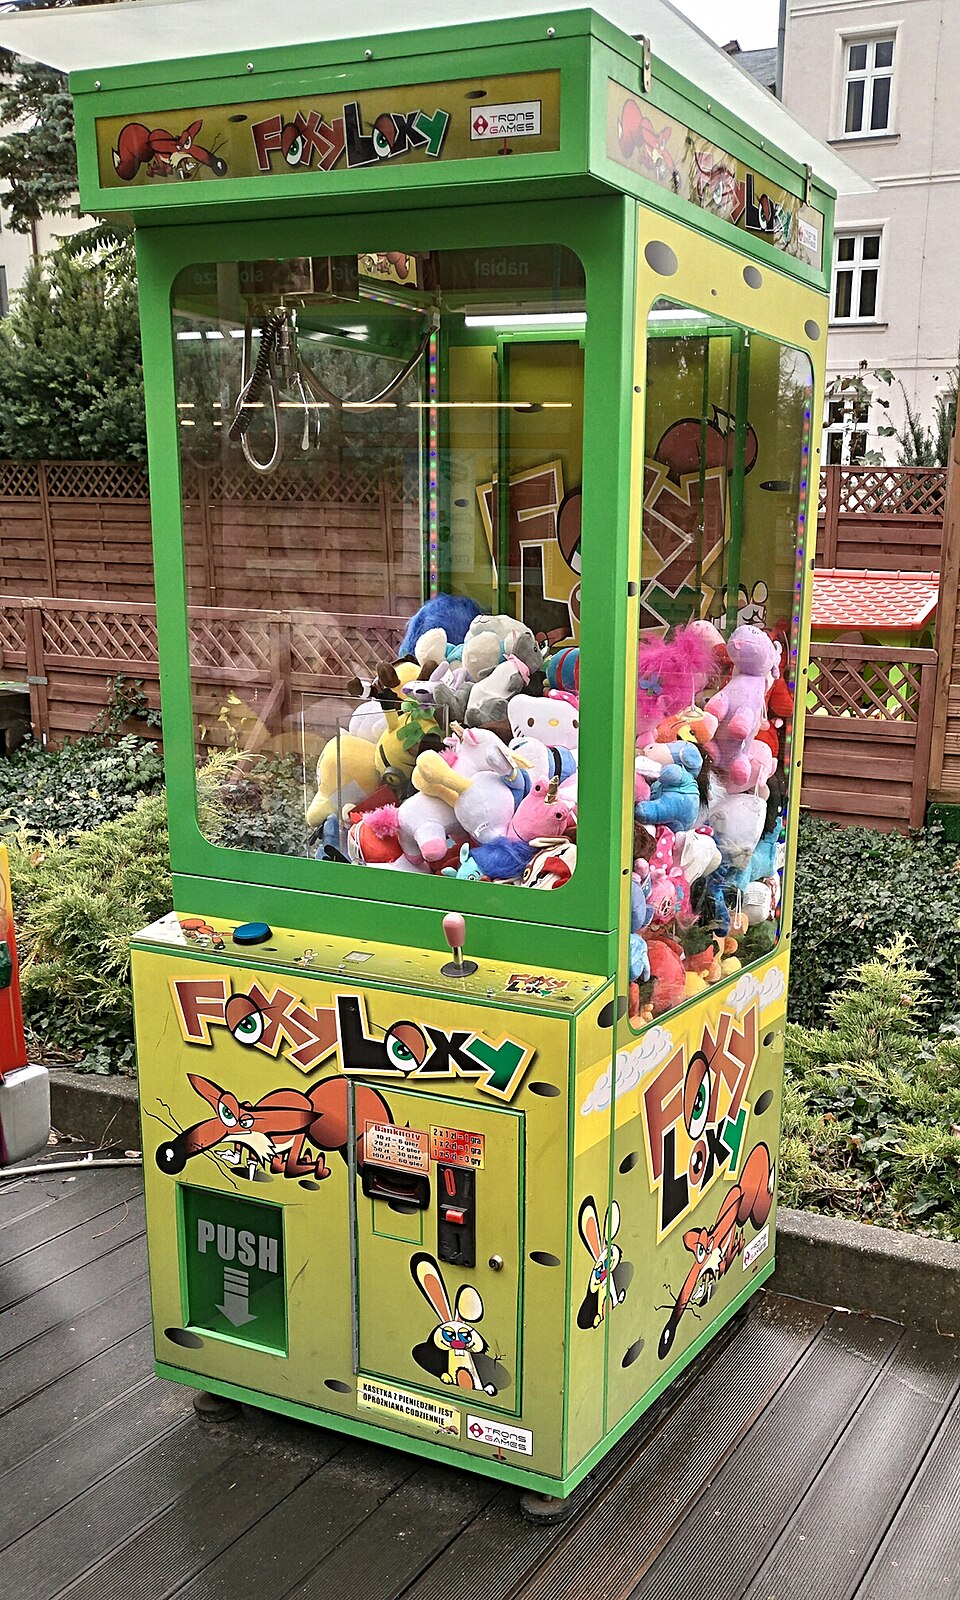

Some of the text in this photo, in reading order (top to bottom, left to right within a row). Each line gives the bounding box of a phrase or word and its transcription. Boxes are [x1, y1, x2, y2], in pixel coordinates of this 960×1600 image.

[490, 112, 534, 122] TRONS
[490, 123, 534, 134] GAMES
[374, 1124, 421, 1141] Banknoty
[433, 1128, 438, 1136] 2
[470, 1136, 481, 1145] gra
[445, 1140, 450, 1149] 2
[470, 1147, 481, 1156] gra
[445, 1151, 450, 1159] 5
[464, 1155, 470, 1163] 3
[470, 1157, 481, 1167] gry
[197, 1218, 278, 1274] PUSH
[362, 1382, 393, 1399] KASETKA
[393, 1392, 398, 1401] Z
[437, 1407, 454, 1418] JEST
[405, 1406, 445, 1426] CODZIENNIE
[485, 1426, 527, 1443] TRONS
[485, 1434, 527, 1451] GAMES
